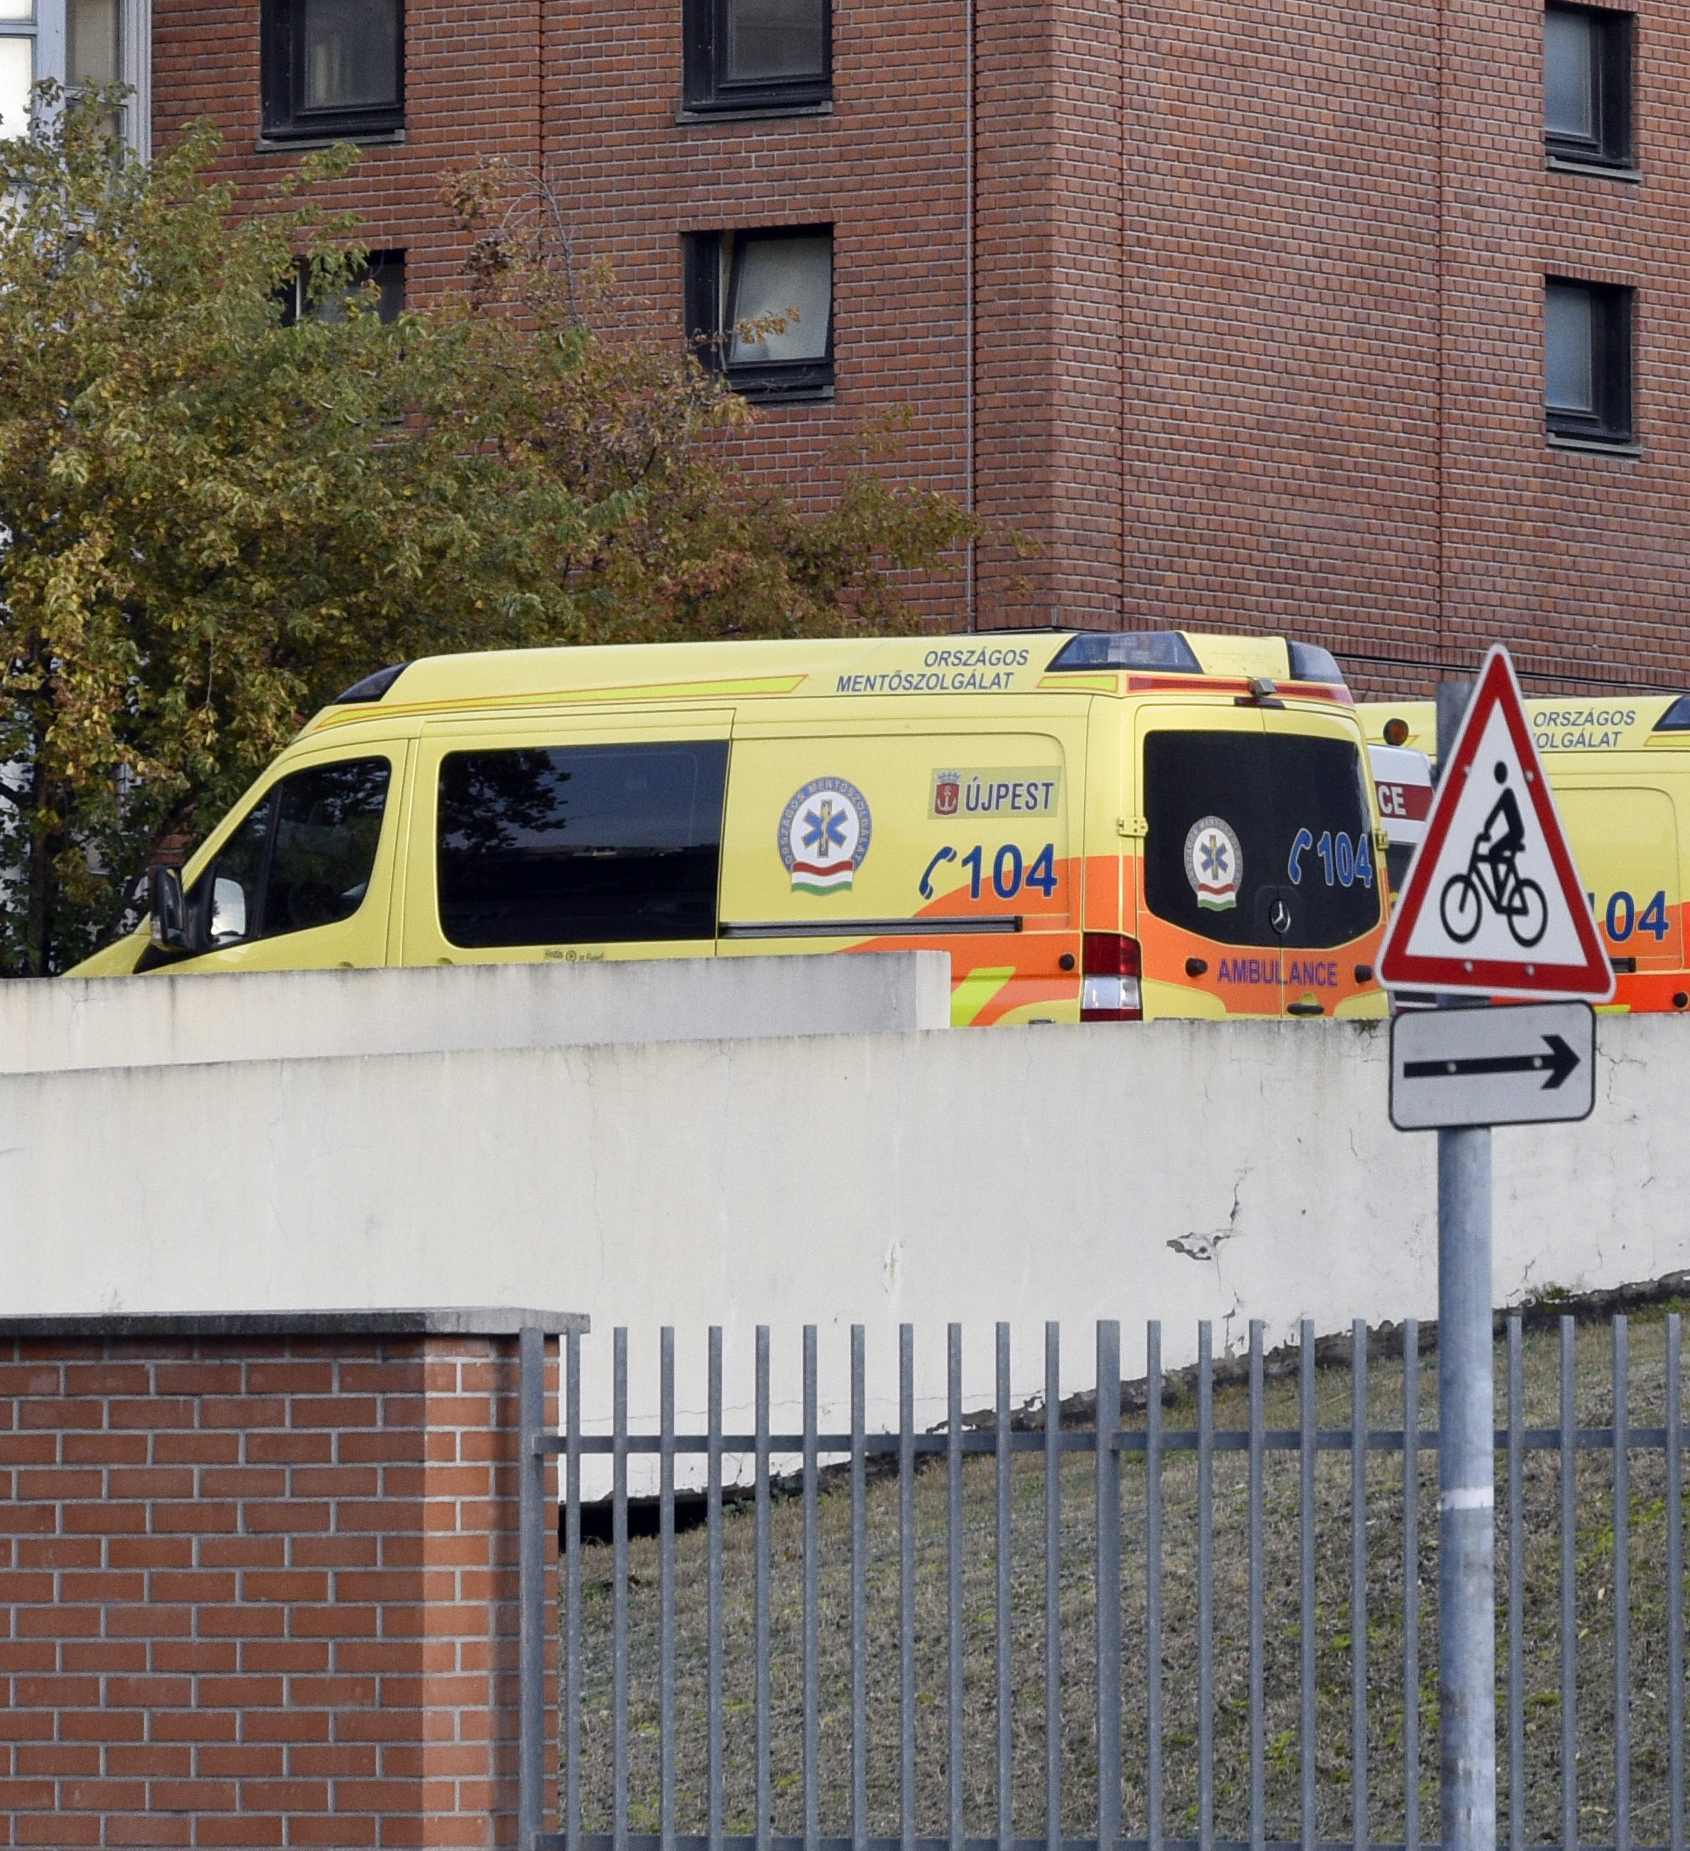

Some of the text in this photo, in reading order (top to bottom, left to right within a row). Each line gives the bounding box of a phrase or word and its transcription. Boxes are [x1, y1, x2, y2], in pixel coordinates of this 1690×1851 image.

[923, 646, 1030, 668] ORSZÁGOS
[836, 669, 1014, 693] MENTŐSZOLGÁLAT
[1533, 708, 1636, 728] ORSZÁGOS
[1534, 728, 1622, 748] OLGÁLAT
[965, 776, 1054, 812] ÚJPEST
[961, 843, 1058, 899] 104
[1317, 831, 1373, 889] 104
[1217, 958, 1338, 987] AMBULANCE
